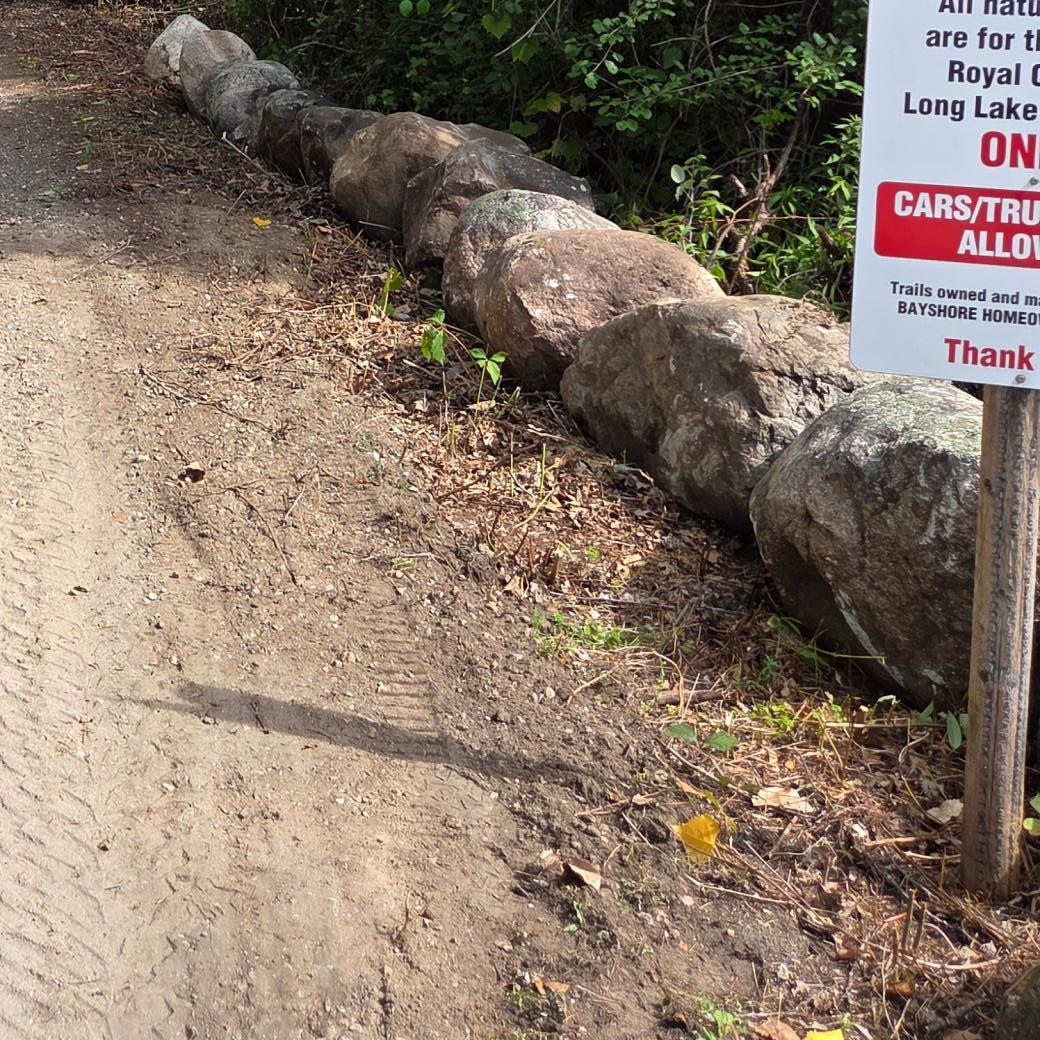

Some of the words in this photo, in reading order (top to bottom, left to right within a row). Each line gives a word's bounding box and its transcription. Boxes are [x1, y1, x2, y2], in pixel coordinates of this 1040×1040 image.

[925, 29, 968, 49] are
[977, 26, 1015, 51] for
[1024, 29, 1040, 52] t
[948, 59, 1021, 89] Royal
[903, 91, 965, 122] Long
[974, 95, 1038, 121] Lake
[980, 130, 1040, 170] ON
[894, 190, 1040, 226] CARS/TRU
[890, 281, 933, 298] Trails
[937, 288, 987, 302] owned
[991, 291, 1020, 305] and
[897, 300, 978, 321] BAYSHORE
[982, 308, 1040, 327] HOMEO
[943, 337, 1036, 371] Thank
